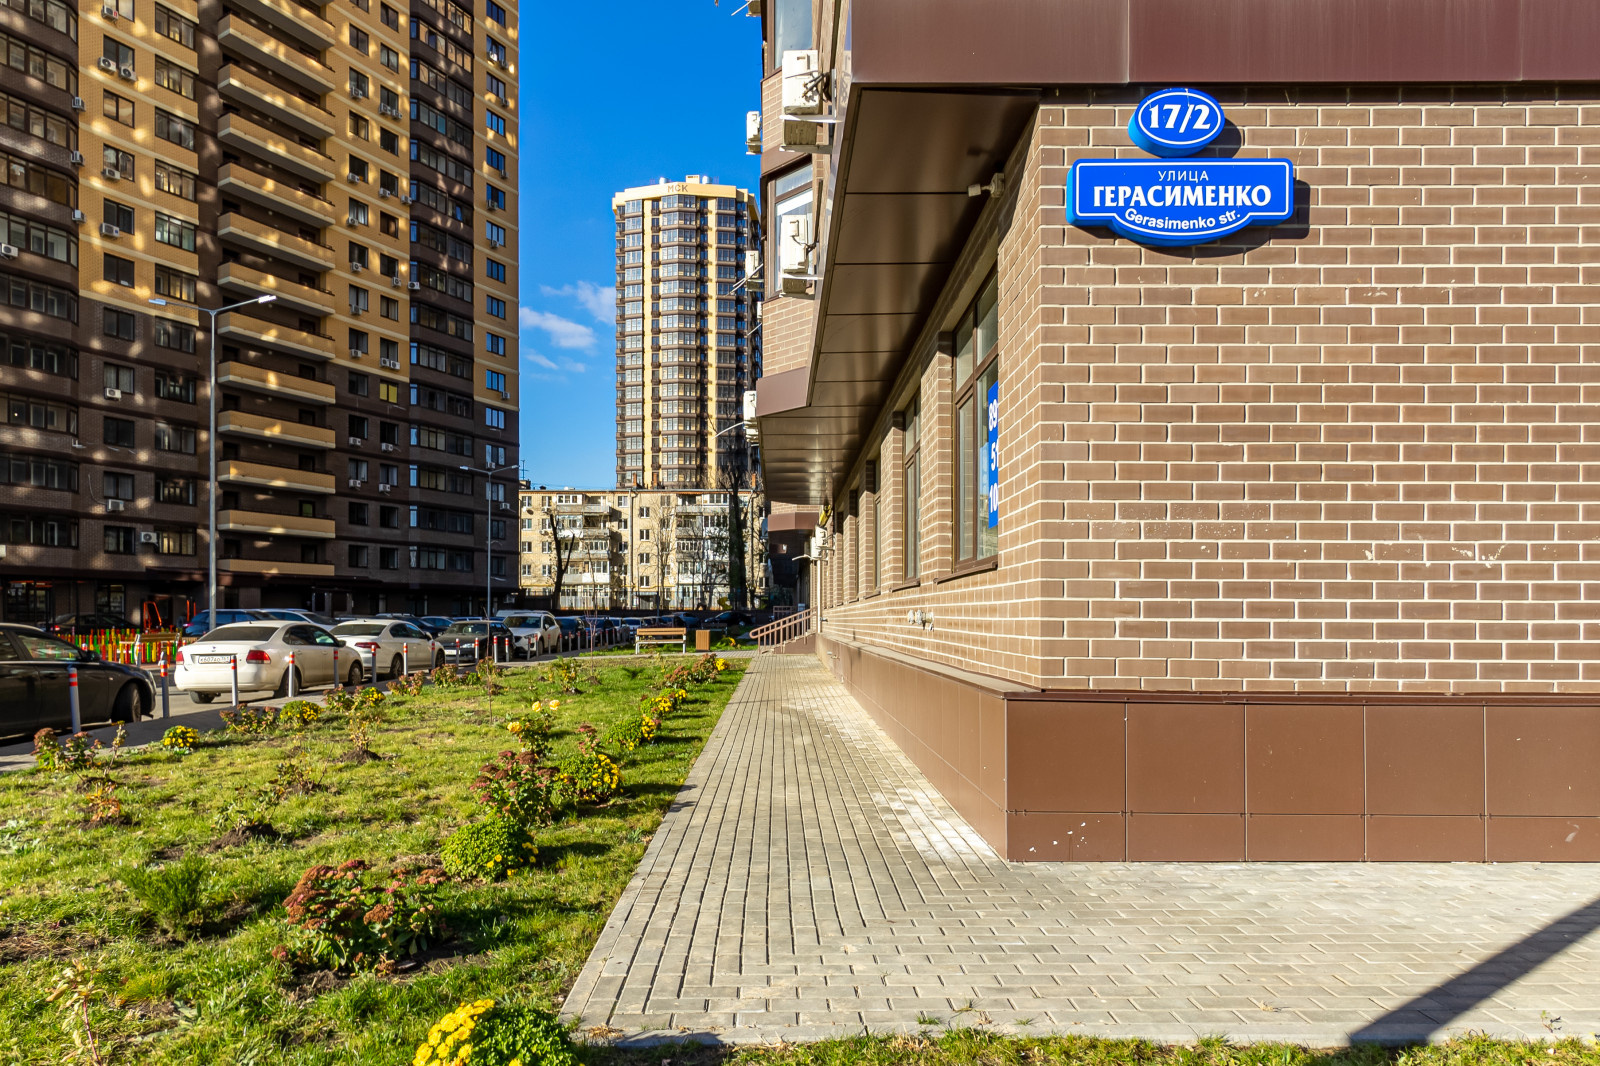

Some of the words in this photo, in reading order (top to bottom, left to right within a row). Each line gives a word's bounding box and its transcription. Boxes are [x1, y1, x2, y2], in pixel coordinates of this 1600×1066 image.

[1149, 103, 1211, 133] 17/2
[1158, 170, 1209, 183] УЛИЦА
[1093, 184, 1272, 207] ГЕРАСИМЕНКО
[1125, 207, 1216, 230] Gerasimenko
[1218, 210, 1241, 225] str.
[989, 398, 998, 431] 89
